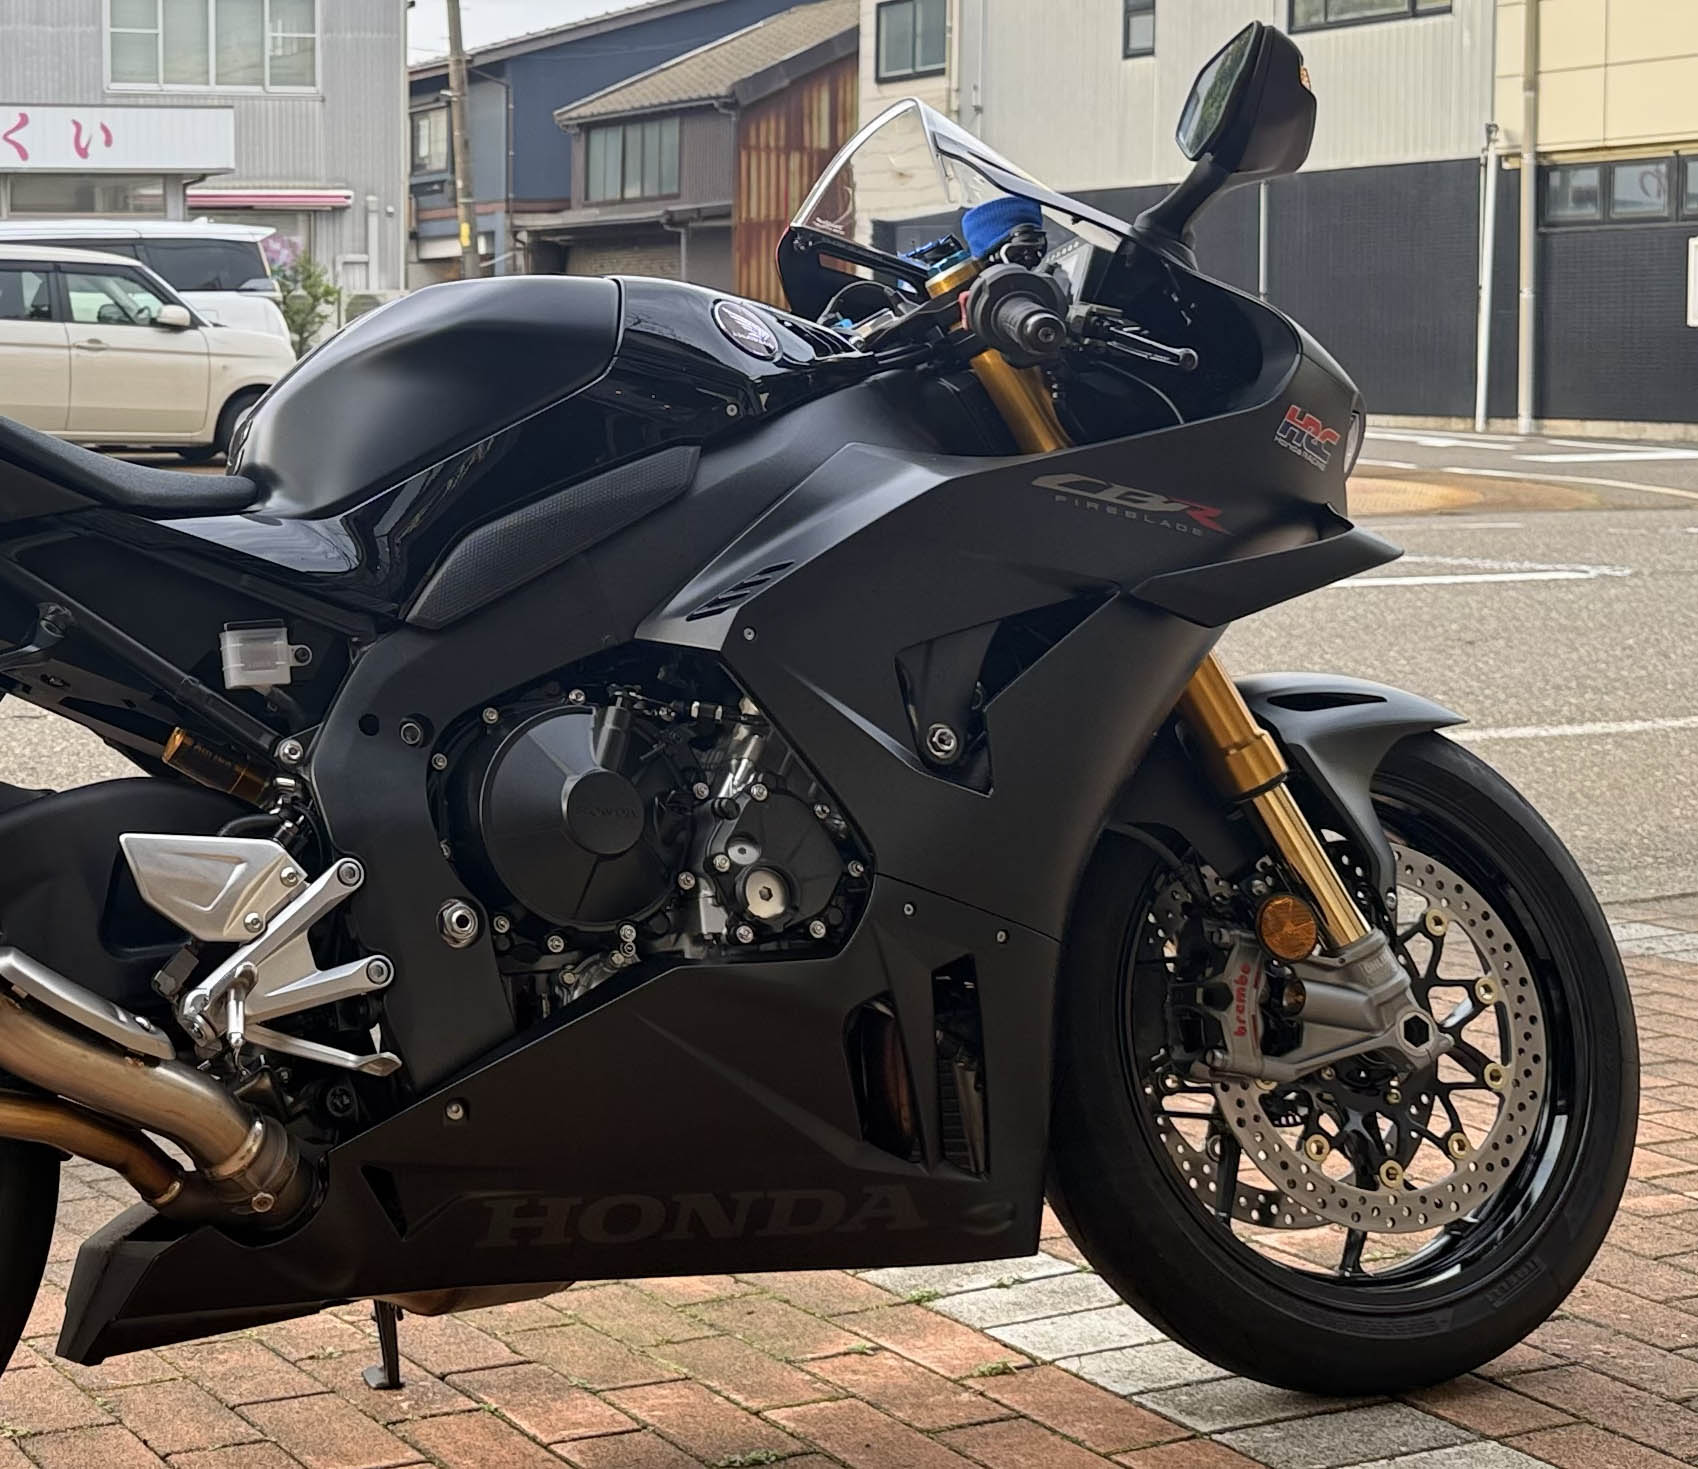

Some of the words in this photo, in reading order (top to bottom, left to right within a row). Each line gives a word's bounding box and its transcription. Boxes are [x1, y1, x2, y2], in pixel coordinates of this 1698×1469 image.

[1276, 404, 1341, 465] HRC
[1031, 473, 1232, 535] CBR
[1055, 495, 1204, 537] FIREBLADE
[1232, 963, 1251, 1037] brembo
[474, 1184, 928, 1248] HONDA
